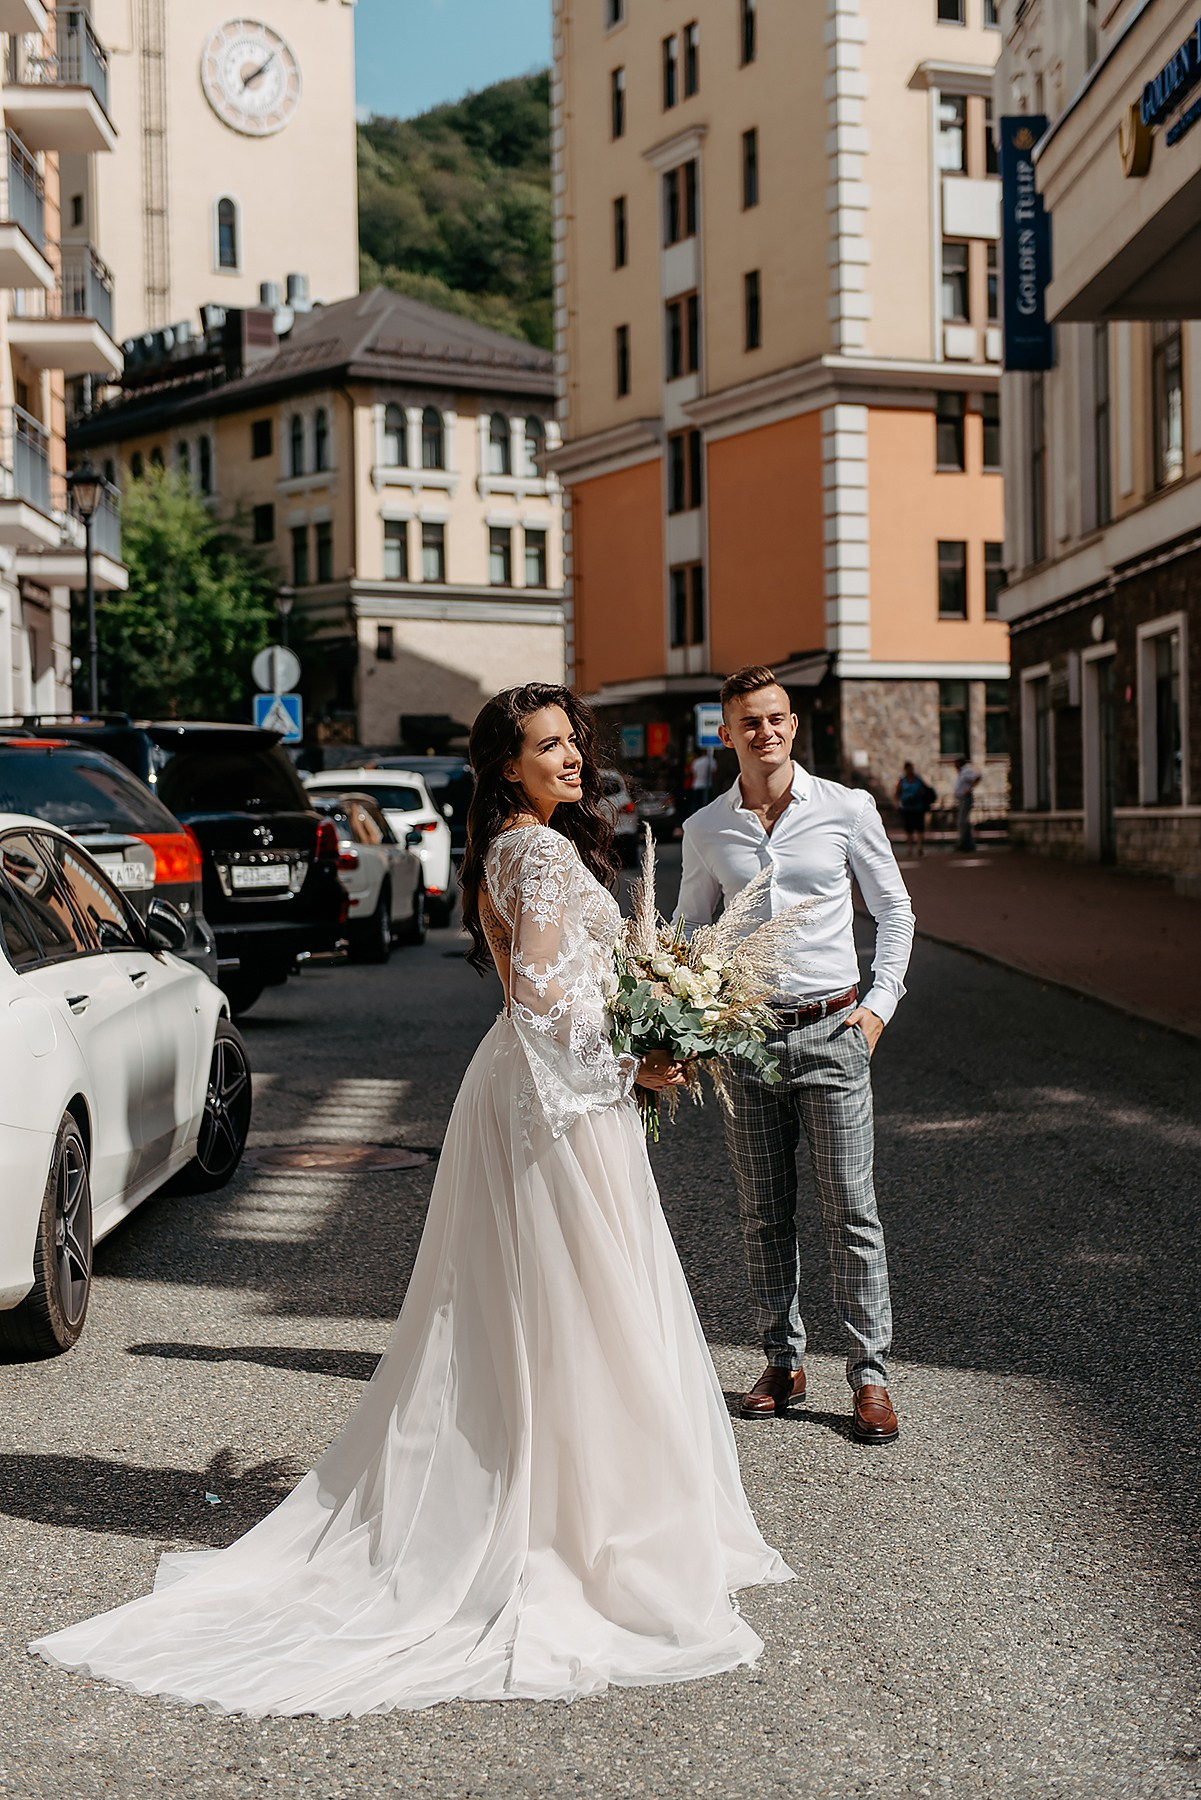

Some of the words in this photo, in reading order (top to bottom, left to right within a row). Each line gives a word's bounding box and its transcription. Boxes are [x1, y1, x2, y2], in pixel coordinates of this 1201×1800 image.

[1140, 38, 1190, 126] GOLDEN
[1014, 160, 1036, 224] TULIP
[1016, 228, 1037, 315] GOLDEN
